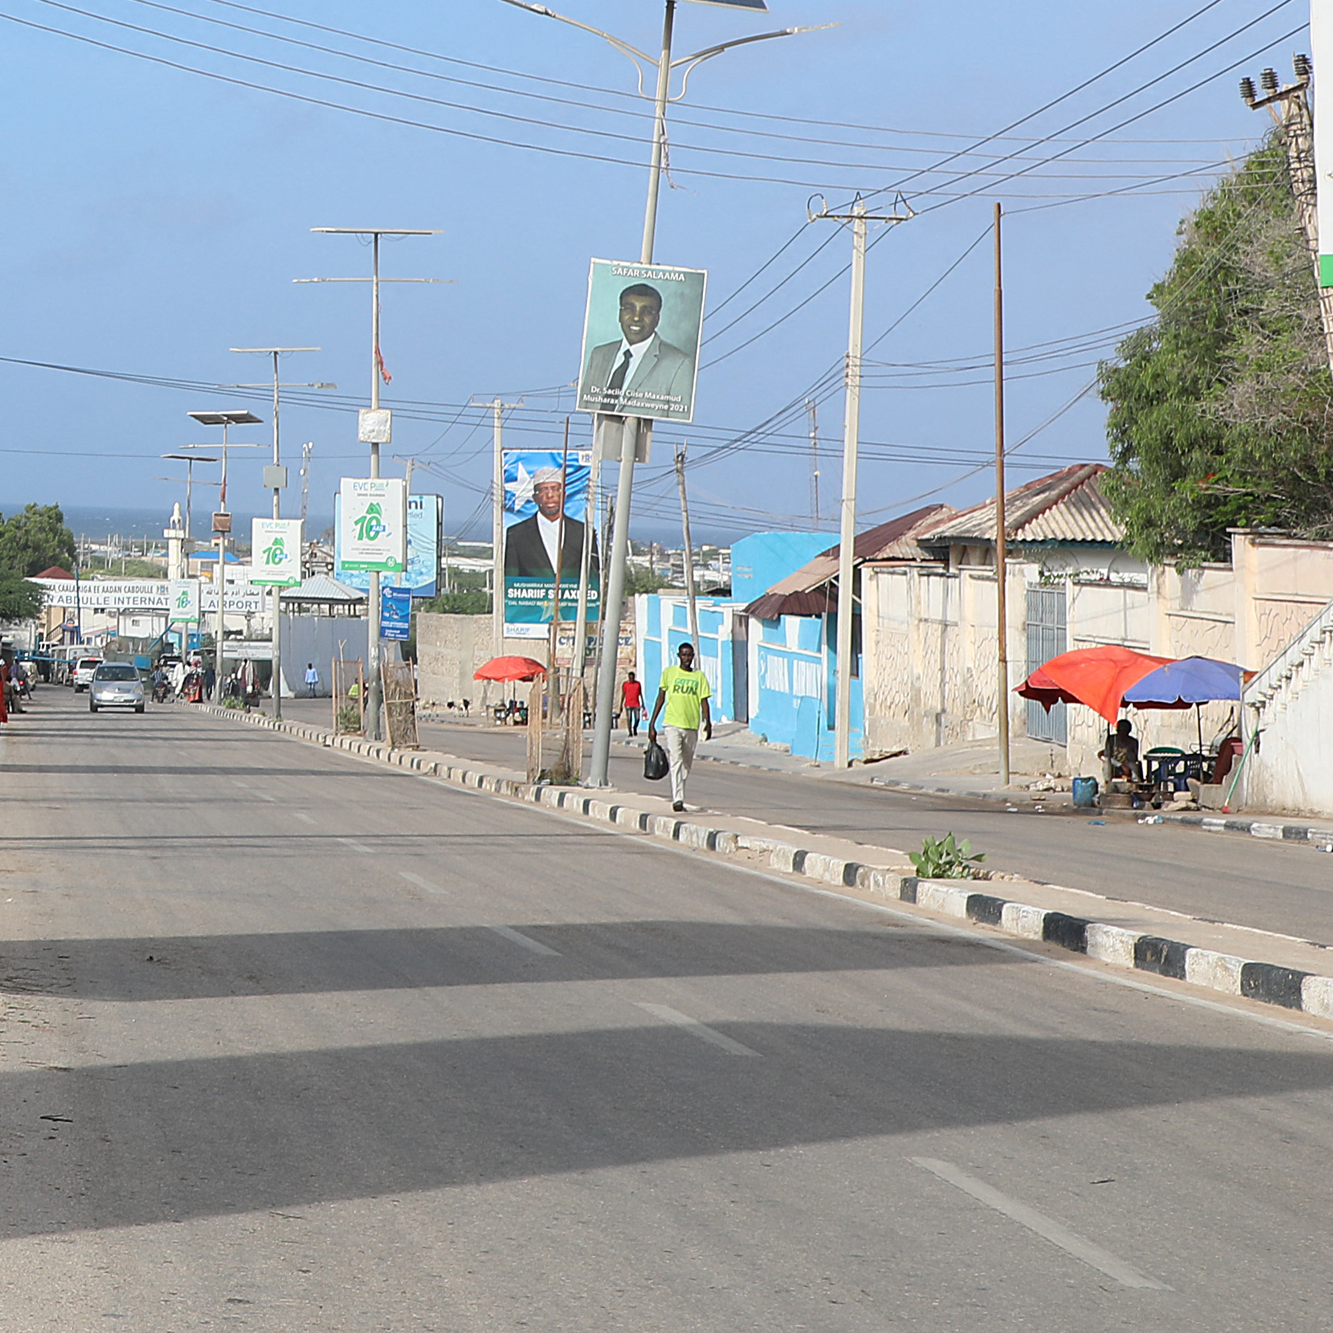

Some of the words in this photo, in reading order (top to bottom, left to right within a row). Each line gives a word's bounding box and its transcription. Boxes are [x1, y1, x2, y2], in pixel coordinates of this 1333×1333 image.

[611, 267, 640, 277] SAFAR
[641, 269, 685, 282] SALAAMA
[591, 385, 602, 394] Dr.
[645, 392, 681, 402] Maxamud
[583, 394, 619, 404] Musharax
[620, 398, 669, 411] Madaxweyne
[669, 404, 688, 412] 2021
[354, 516, 382, 541] 10
[507, 588, 546, 598] SHARIIF
[673, 684, 698, 695] RUN
